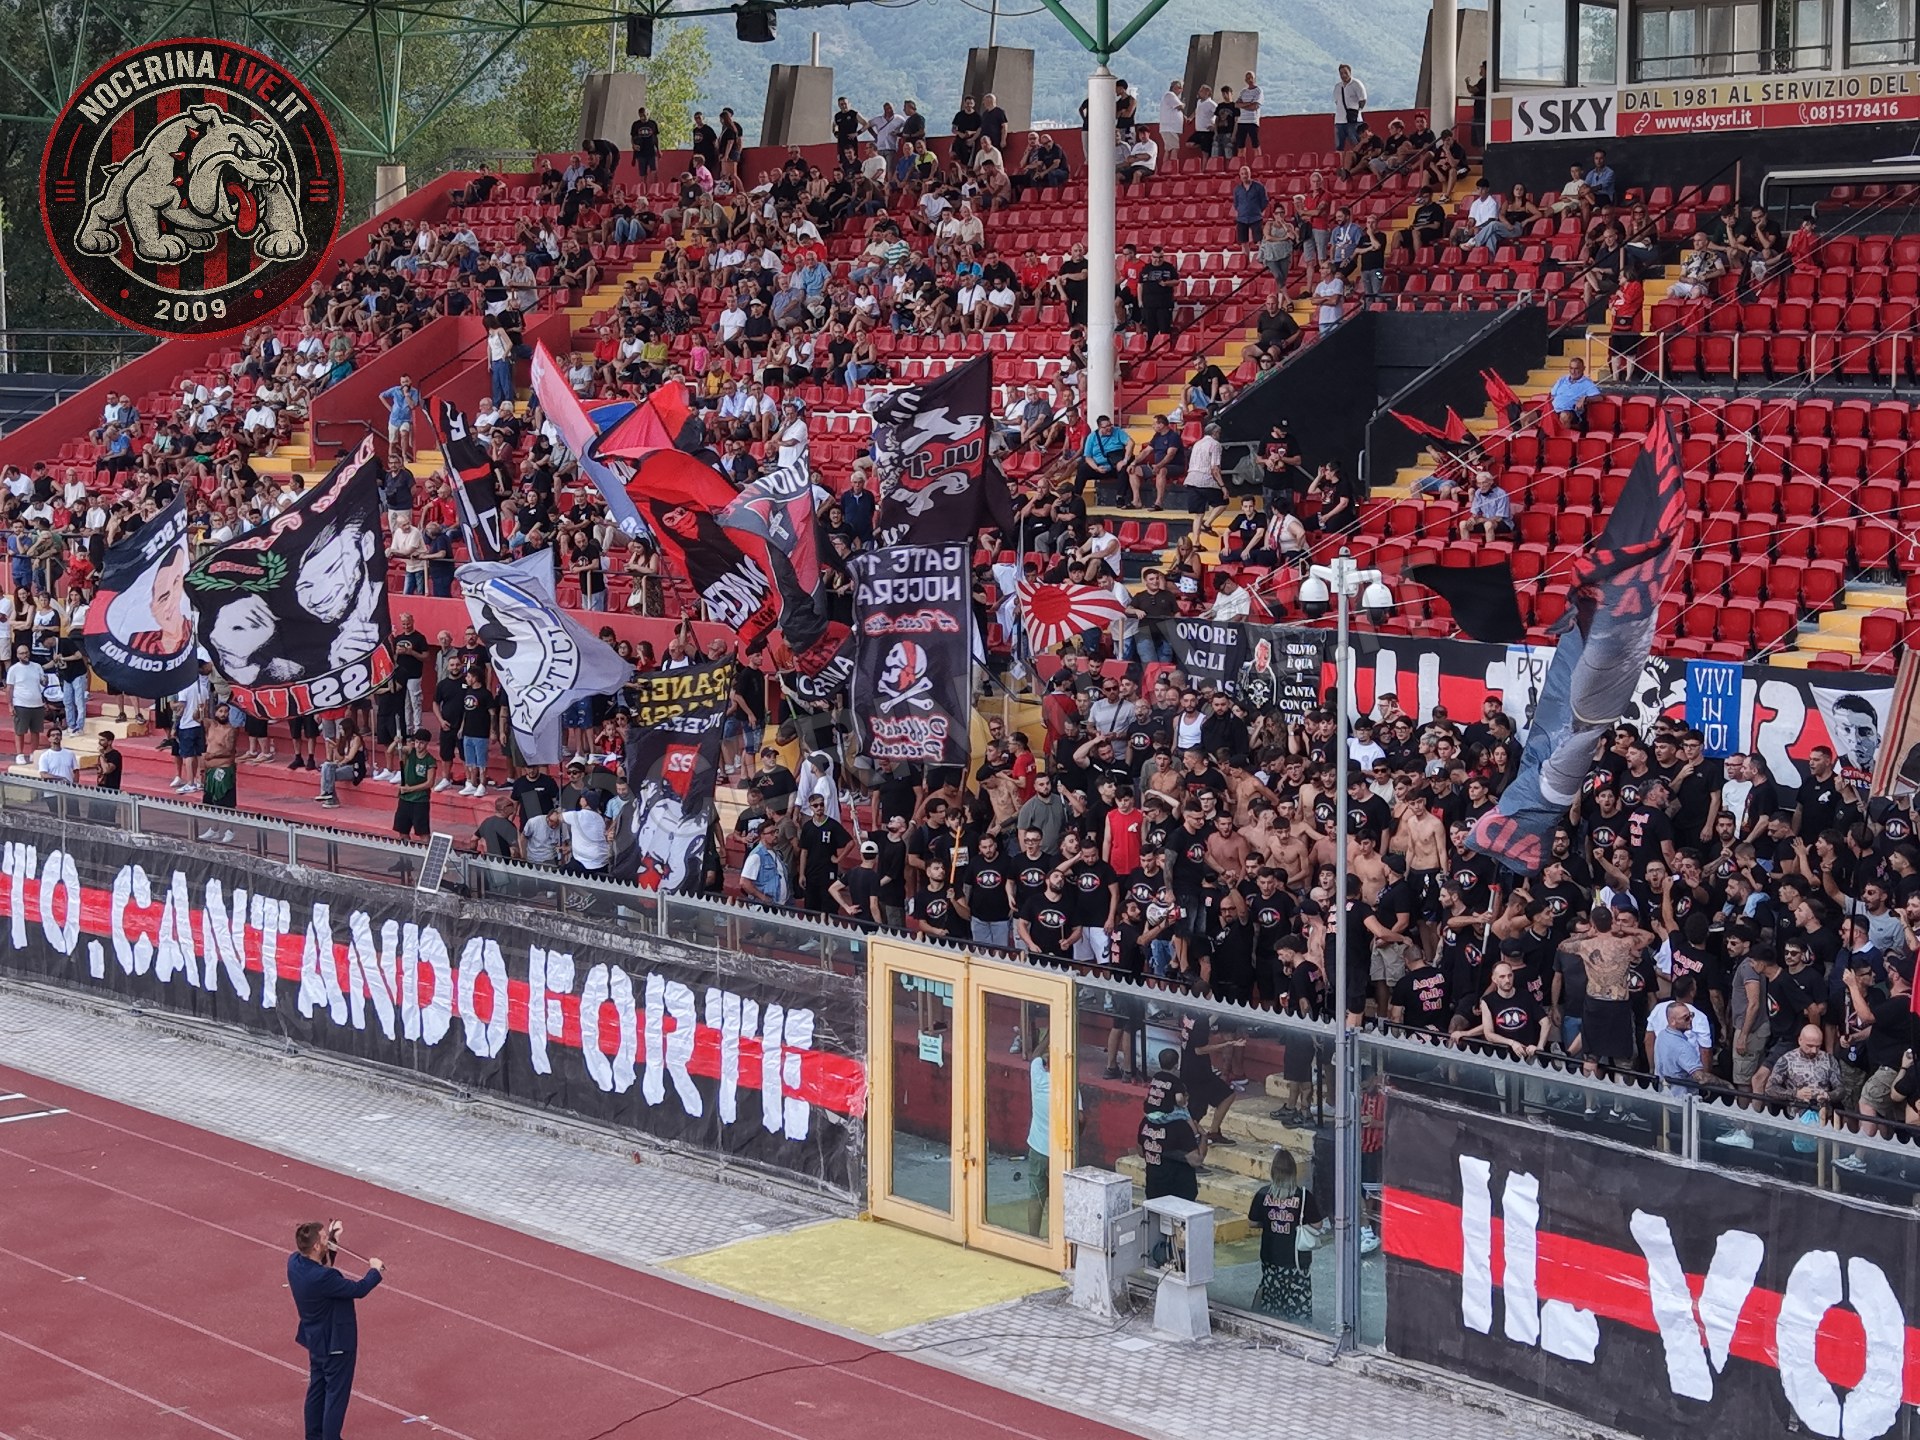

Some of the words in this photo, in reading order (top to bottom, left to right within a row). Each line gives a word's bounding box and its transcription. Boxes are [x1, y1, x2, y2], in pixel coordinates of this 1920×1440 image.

[1625, 89, 1663, 110] DAL
[1673, 87, 1717, 108] 1981
[1728, 86, 1753, 104] AL
[1762, 78, 1860, 101] SERVIZIO
[1869, 75, 1909, 96] DEL
[1539, 97, 1614, 135] SKY
[1655, 109, 1752, 130] www.skysrl.it
[1810, 101, 1899, 121] 0815178416
[1176, 622, 1239, 646] ONORE
[1184, 648, 1227, 671] AGLI
[1286, 643, 1318, 656] SILVIO
[1294, 658, 1314, 671] QUA
[1284, 685, 1317, 698] CANTA
[1694, 667, 1734, 696] VIVI
[1279, 699, 1300, 711] CON
[1702, 697, 1722, 722] IN
[821, 830, 832, 844] H
[528, 943, 815, 1140] FORTE
[1458, 1153, 1600, 1364] IL
